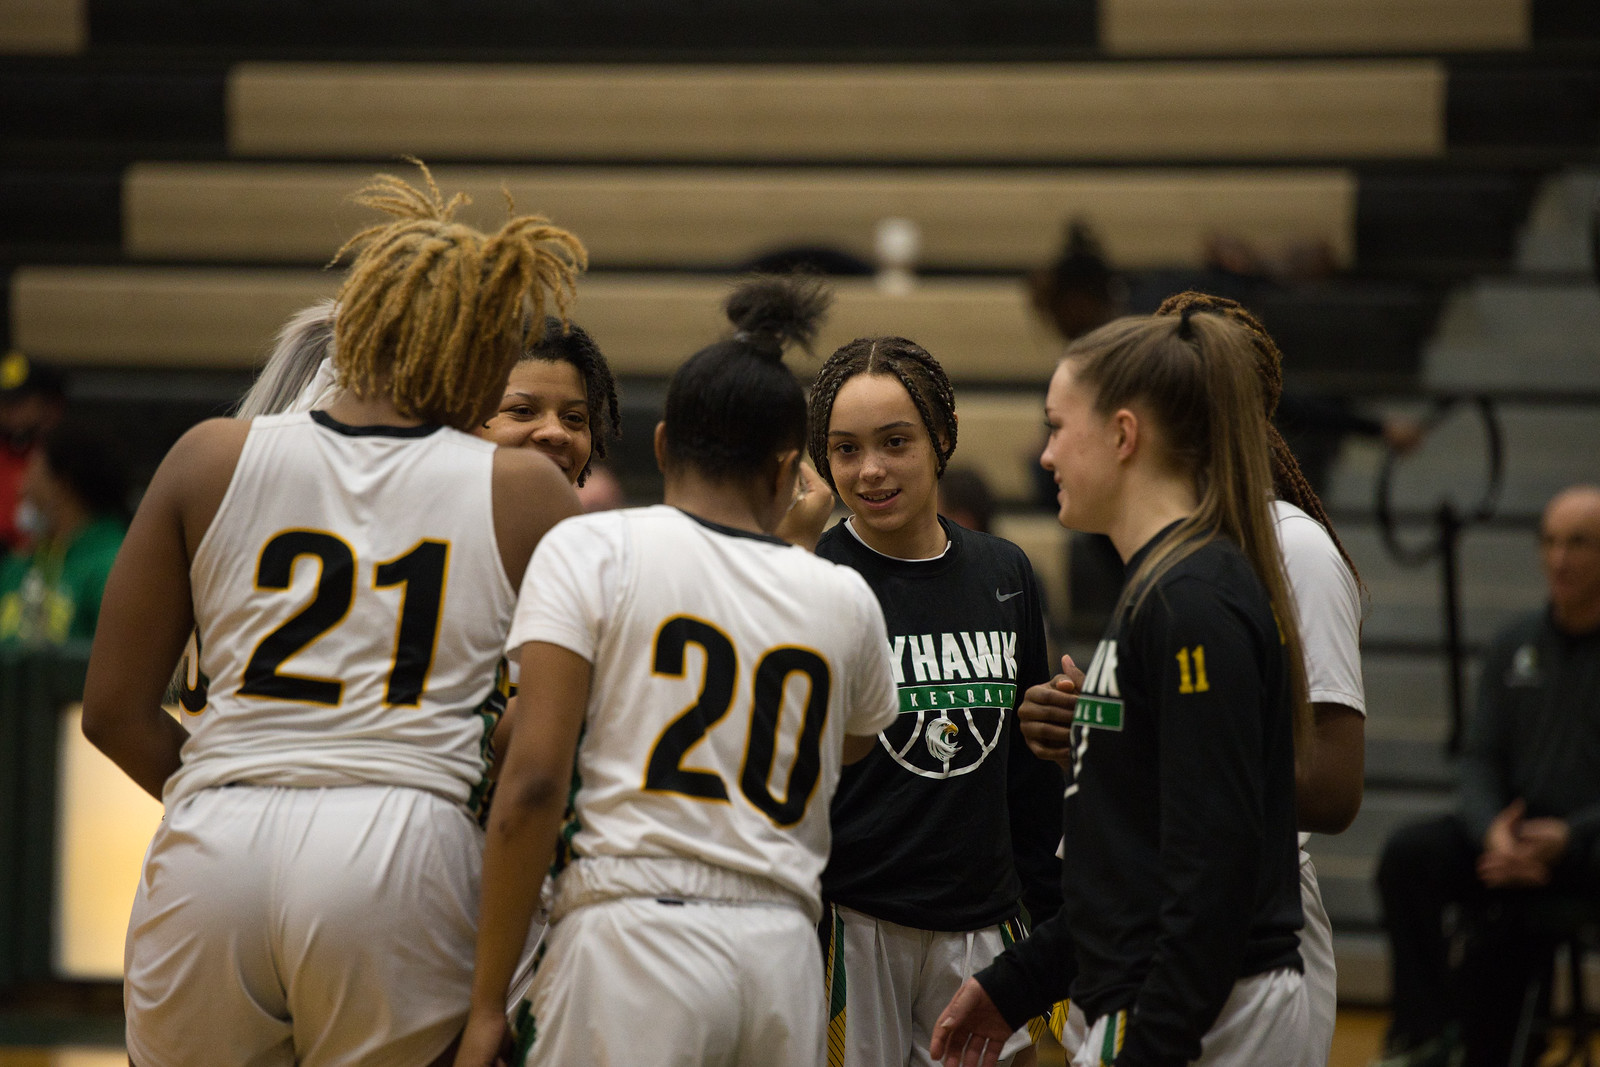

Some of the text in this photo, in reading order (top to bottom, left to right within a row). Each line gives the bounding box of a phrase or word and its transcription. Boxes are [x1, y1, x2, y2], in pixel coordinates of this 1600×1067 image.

[234, 527, 452, 709] 21
[887, 631, 1018, 683] YHAWK
[1175, 644, 1210, 694] 11
[640, 613, 832, 830] 20
